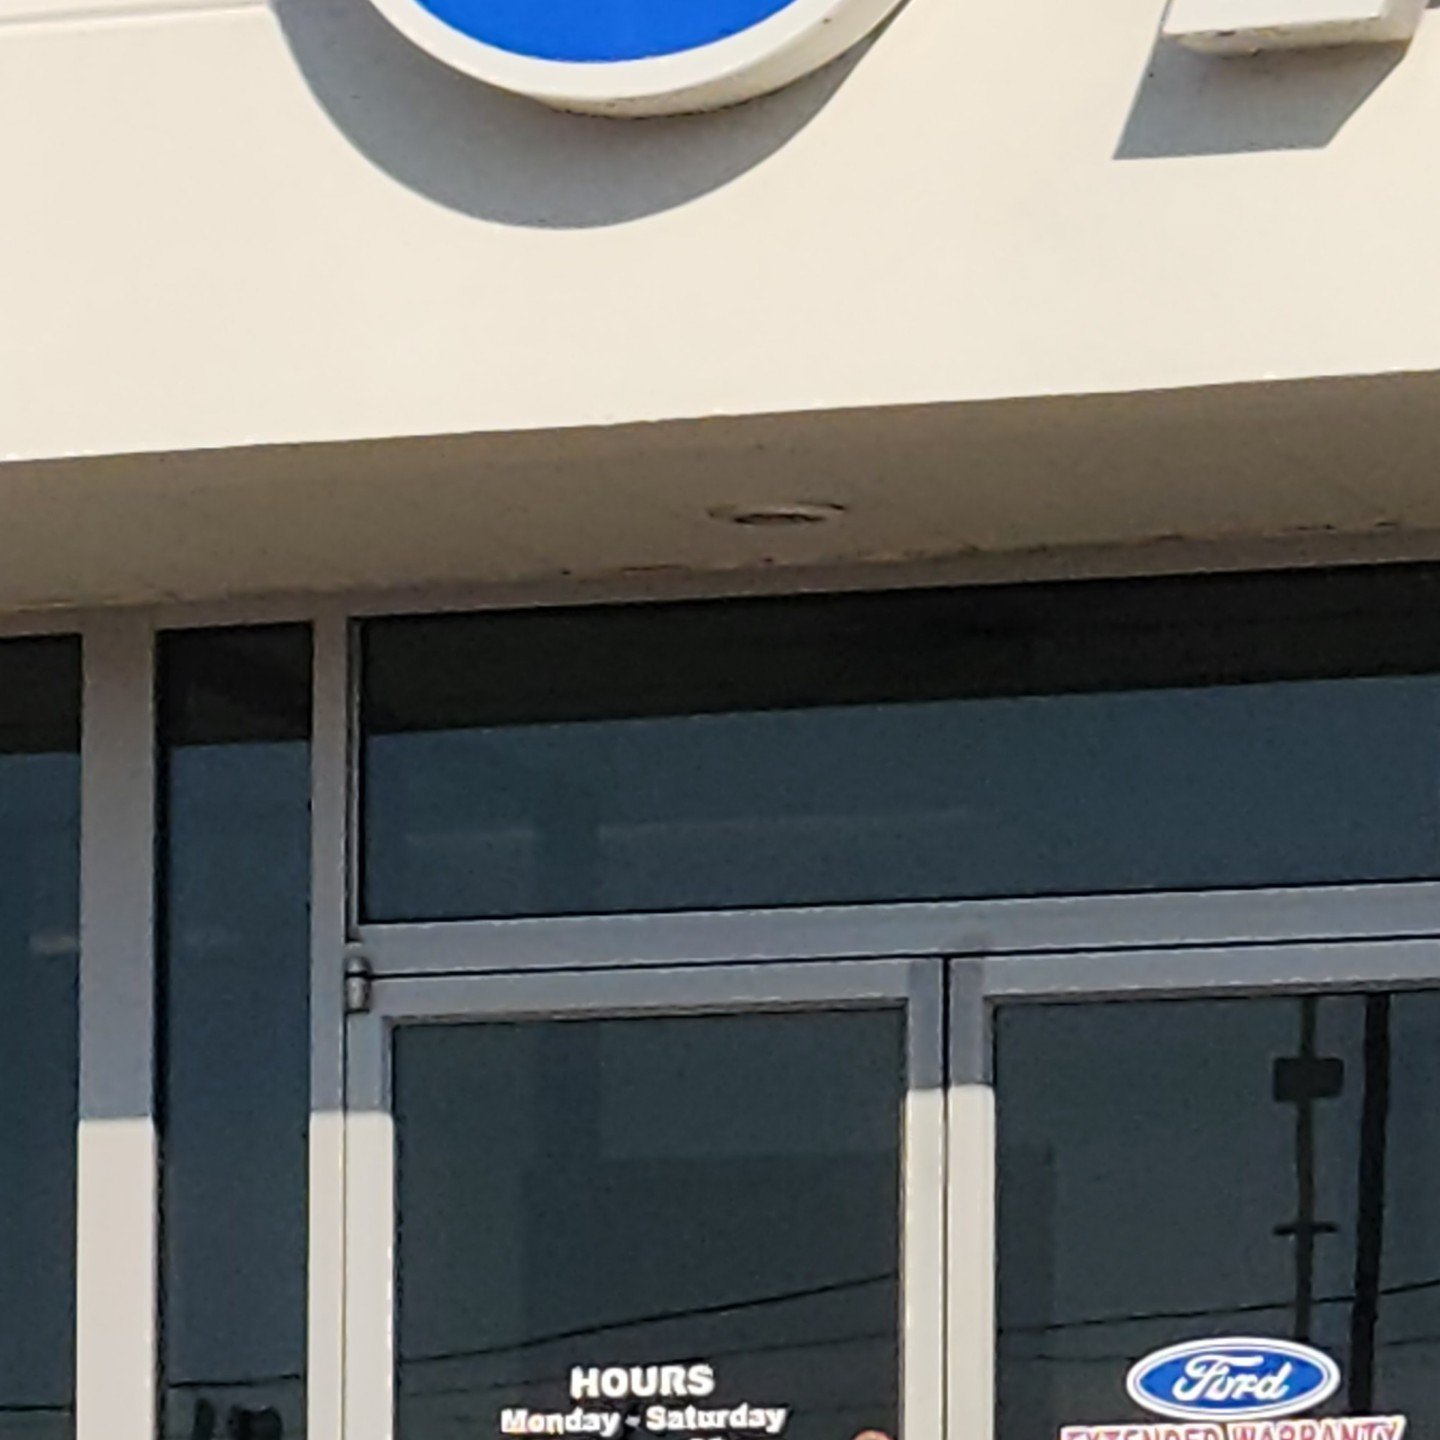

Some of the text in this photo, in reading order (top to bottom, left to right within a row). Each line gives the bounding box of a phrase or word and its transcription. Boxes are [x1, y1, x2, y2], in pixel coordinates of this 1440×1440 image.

[570, 1364, 715, 1399] HOURS
[1171, 1353, 1292, 1402] Ford
[499, 1407, 621, 1436] Monday
[645, 1402, 787, 1433] Saturday
